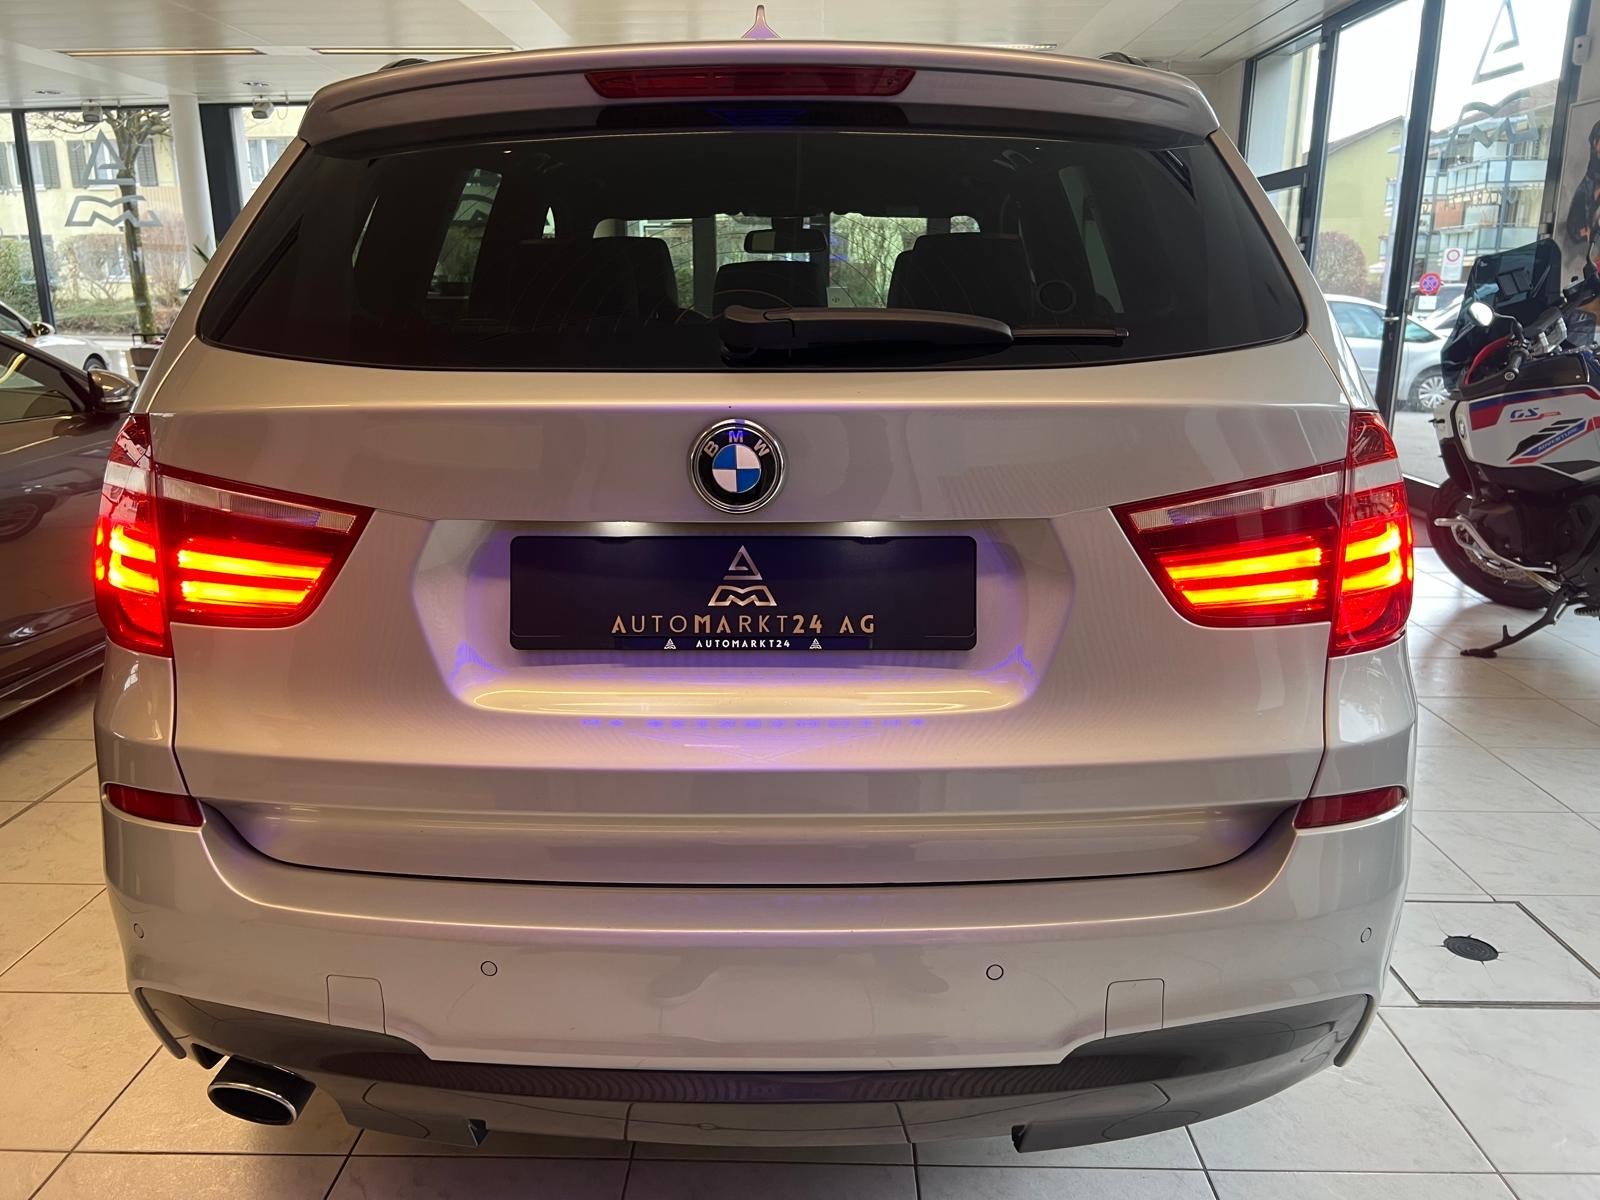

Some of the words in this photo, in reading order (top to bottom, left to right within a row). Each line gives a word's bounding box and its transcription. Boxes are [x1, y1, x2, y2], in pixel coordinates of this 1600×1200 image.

[1510, 407, 1540, 419] GS
[703, 430, 770, 458] BMW
[1537, 426, 1579, 452] ADVENTURE
[611, 614, 823, 634] AUTOMARKT24
[839, 614, 875, 634] AG
[695, 639, 791, 648] AUTOMARKT24
